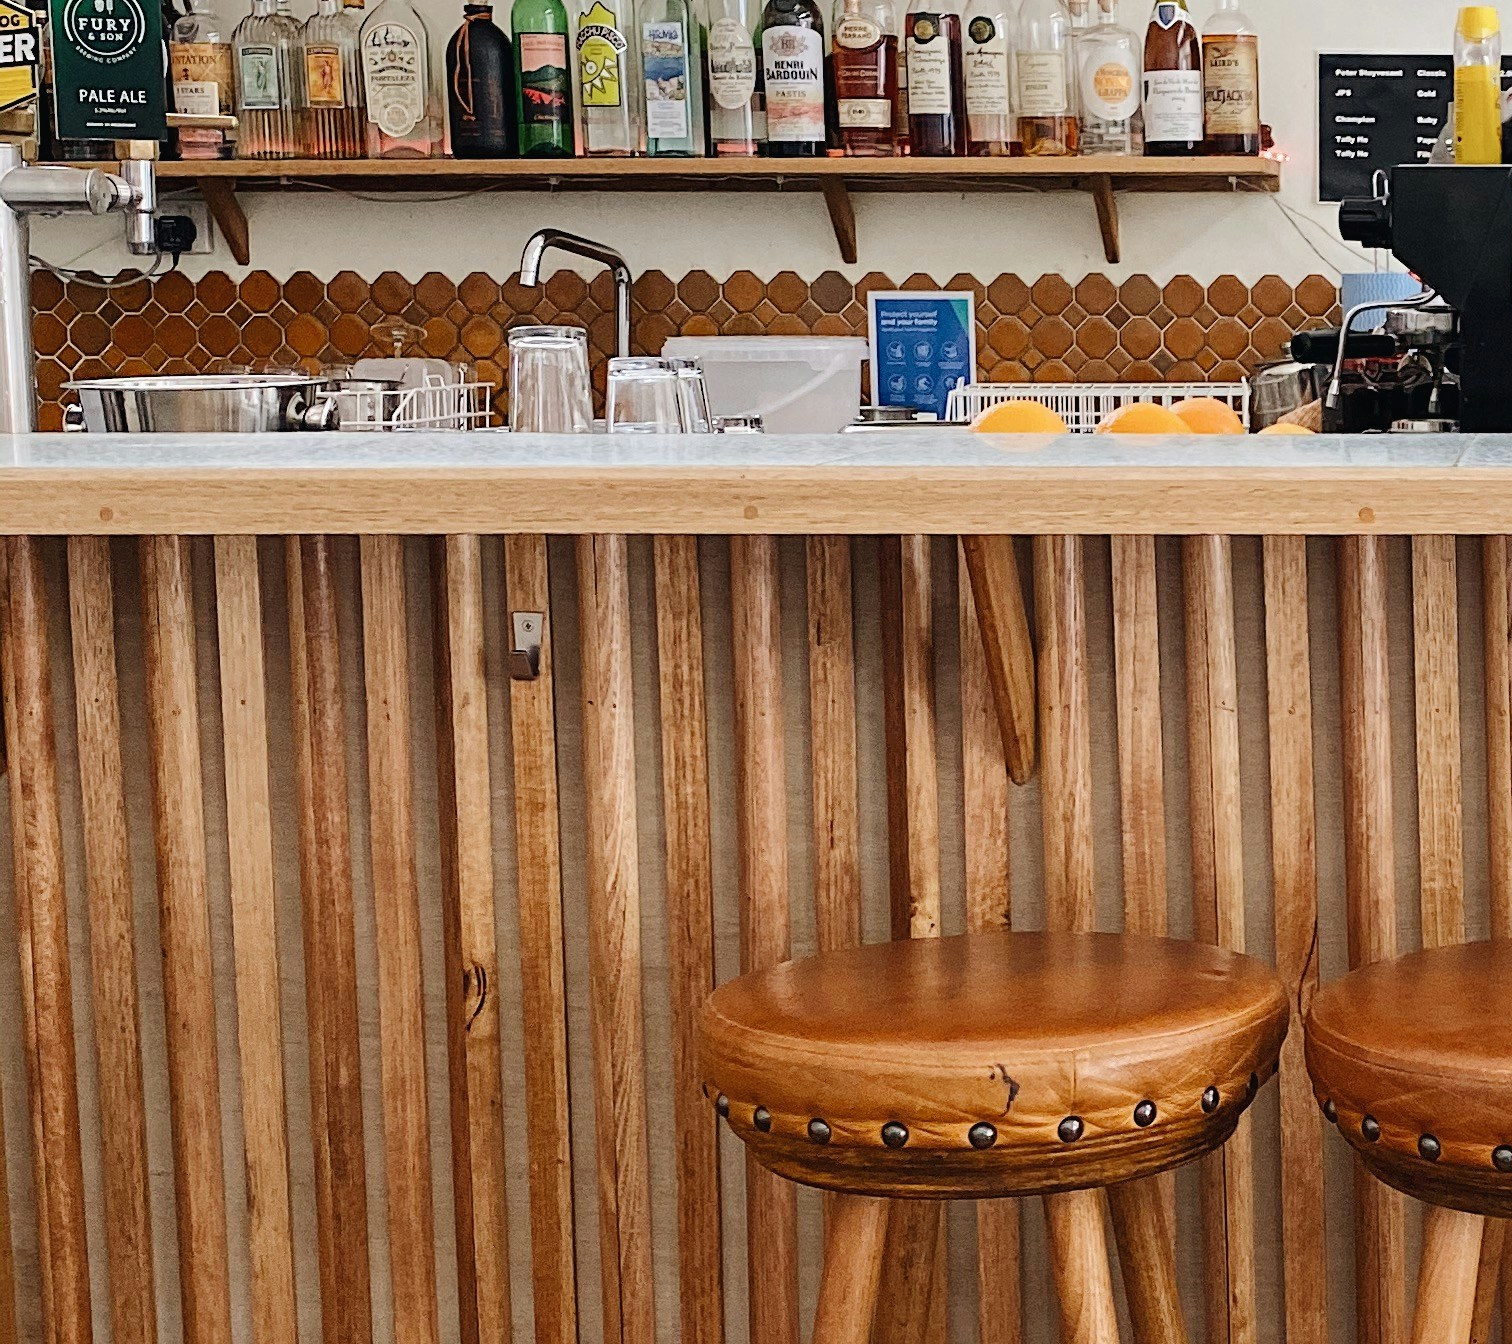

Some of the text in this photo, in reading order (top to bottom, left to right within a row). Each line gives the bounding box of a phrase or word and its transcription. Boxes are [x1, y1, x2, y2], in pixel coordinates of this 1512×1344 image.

[78, 17, 131, 32] FURY
[88, 32, 124, 41] & SON
[106, 46, 137, 64] COMPANY
[774, 59, 804, 69] HENRI
[765, 67, 818, 81] BARDOUIN
[1335, 69, 1357, 77] Peter
[79, 88, 147, 104] PALE ALE
[775, 89, 807, 98] PASTIS
[1335, 89, 1437, 98] JPS Gold
[1335, 115, 1376, 124] Champion
[1335, 136, 1355, 144] Tally
[1356, 136, 1369, 144] Ho
[1335, 150, 1369, 158] Tally Ho
